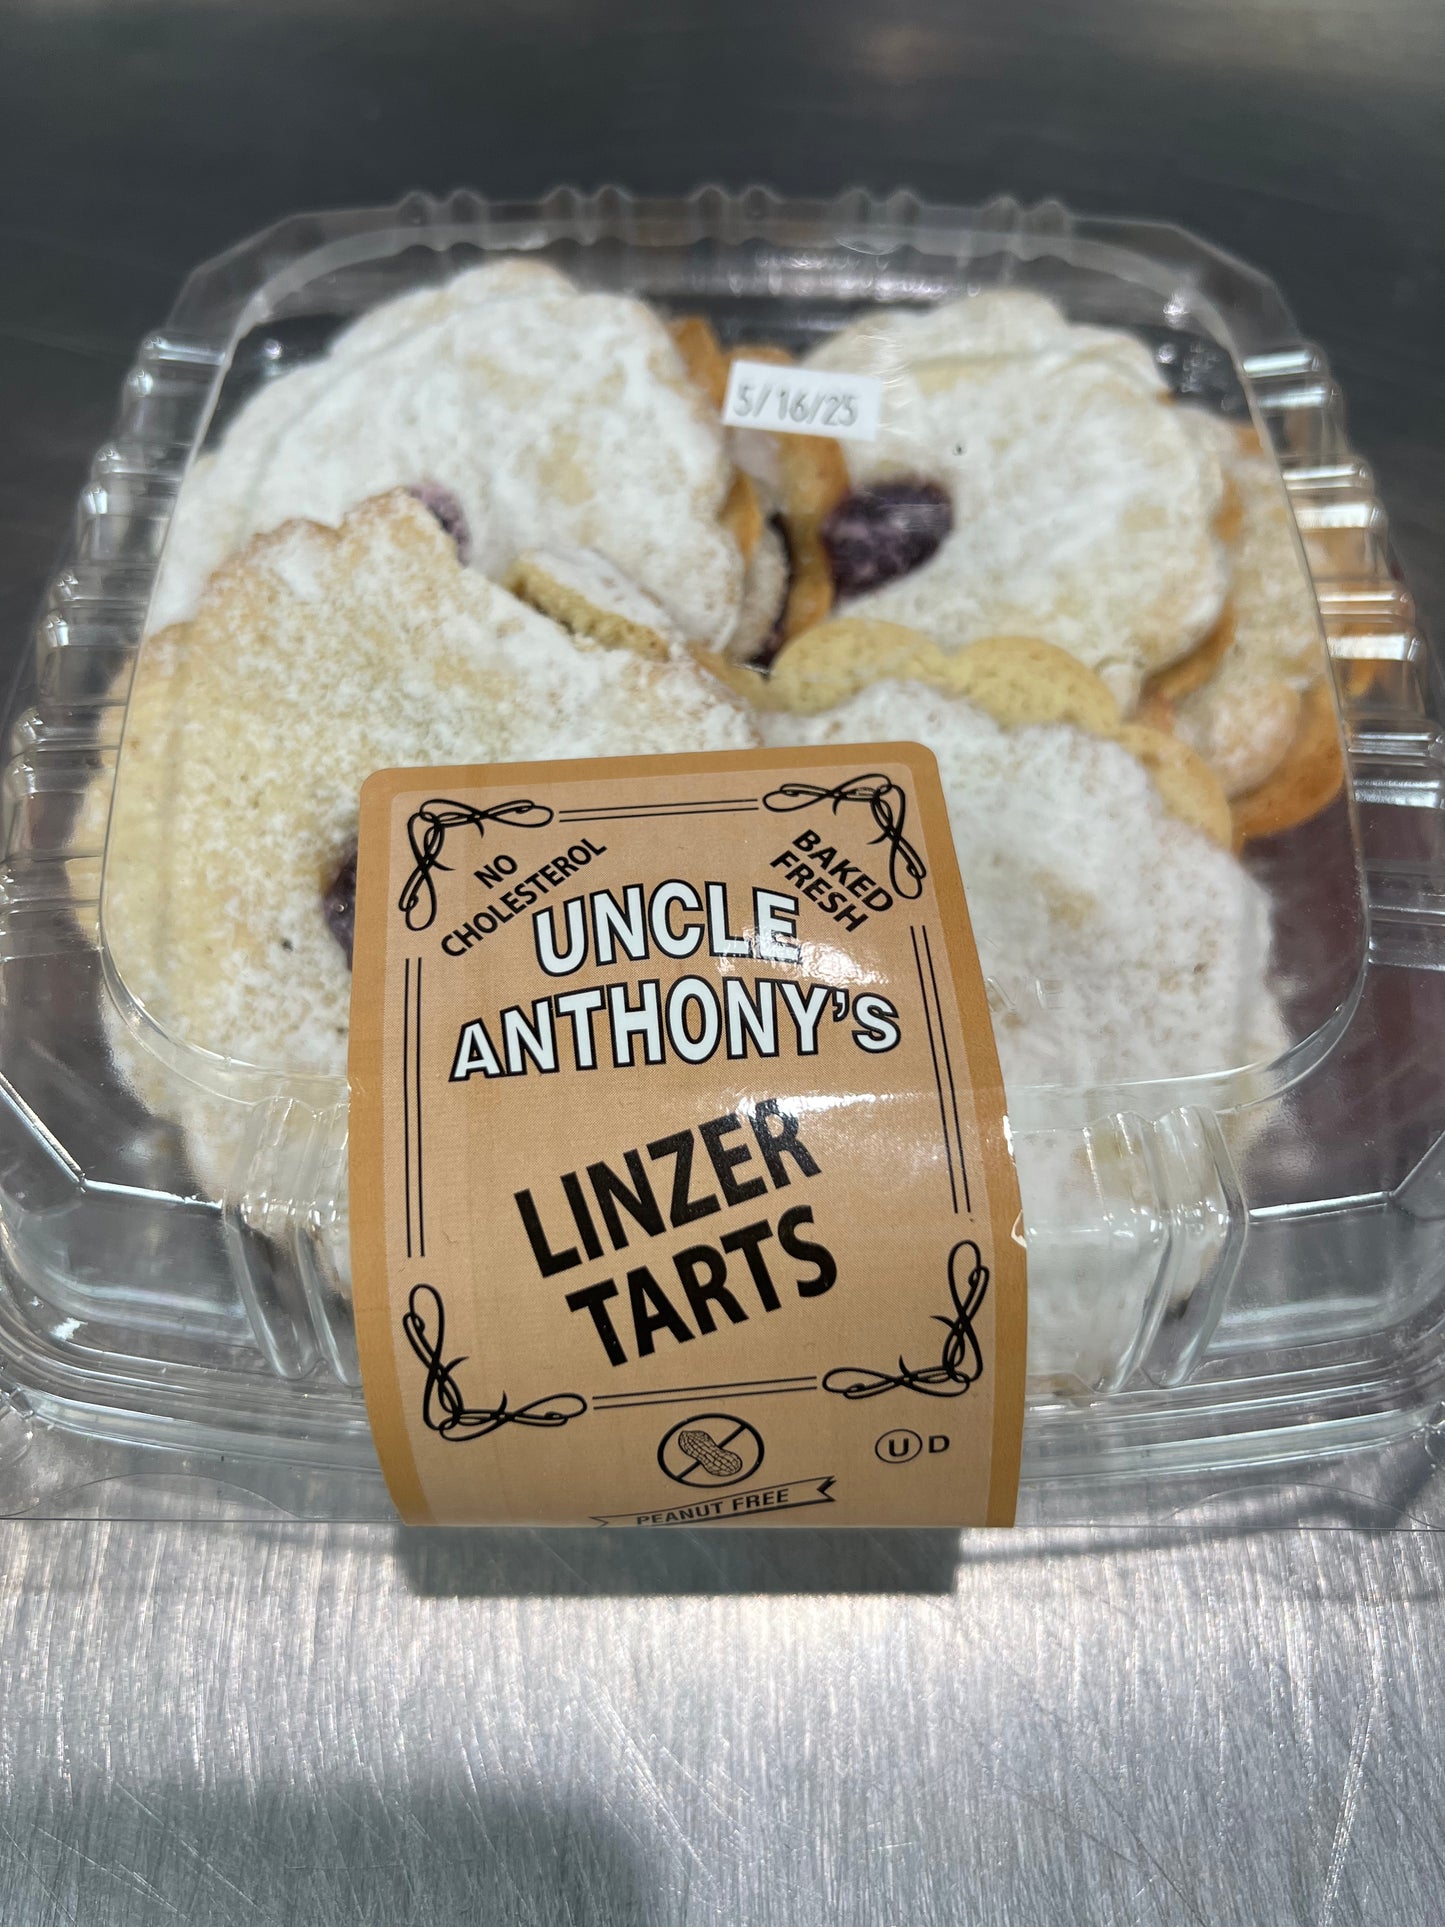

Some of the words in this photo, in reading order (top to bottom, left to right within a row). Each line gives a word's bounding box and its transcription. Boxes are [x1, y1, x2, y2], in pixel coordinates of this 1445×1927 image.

[440, 837, 607, 958] CHOLESTEROL
[473, 853, 520, 891] NO
[769, 849, 869, 933] FRESH
[791, 828, 895, 915] BAKED
[531, 878, 799, 977] UNCLE
[448, 974, 901, 1082] ANTHONY'S
[514, 1099, 822, 1278] LINZER
[565, 1204, 837, 1367] TARTS
[636, 1501, 723, 1525] PEANUT
[732, 1488, 790, 1511] FREE
